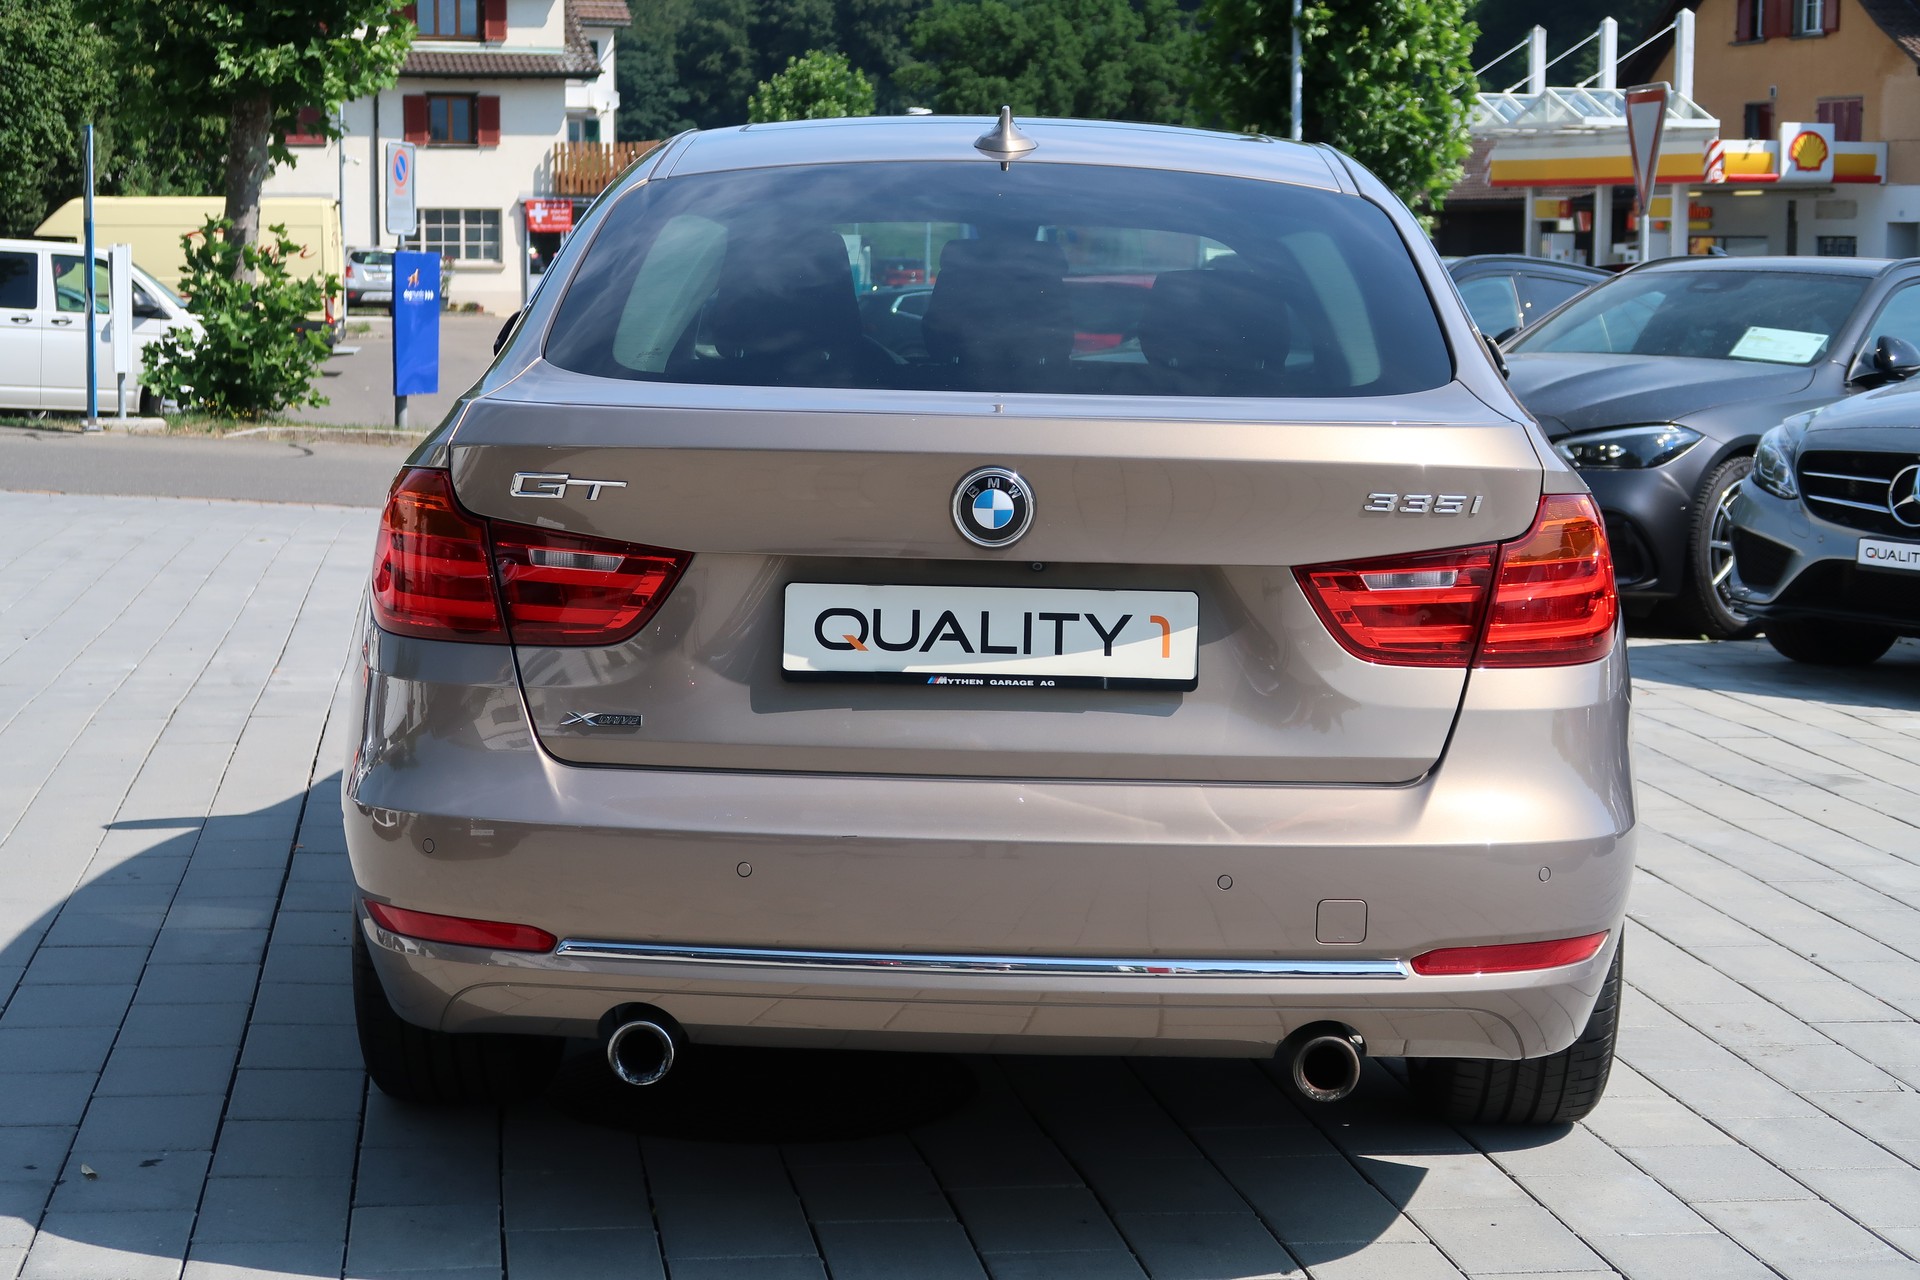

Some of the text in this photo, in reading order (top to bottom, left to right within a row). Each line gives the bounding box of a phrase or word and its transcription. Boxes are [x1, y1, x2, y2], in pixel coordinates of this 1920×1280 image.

[509, 471, 628, 501] GT
[966, 477, 1022, 499] BMW
[1363, 492, 1483, 515] 335i
[814, 606, 1171, 659] QUALITY 1
[937, 676, 984, 686] MYTHEN
[1039, 679, 1056, 687] AG
